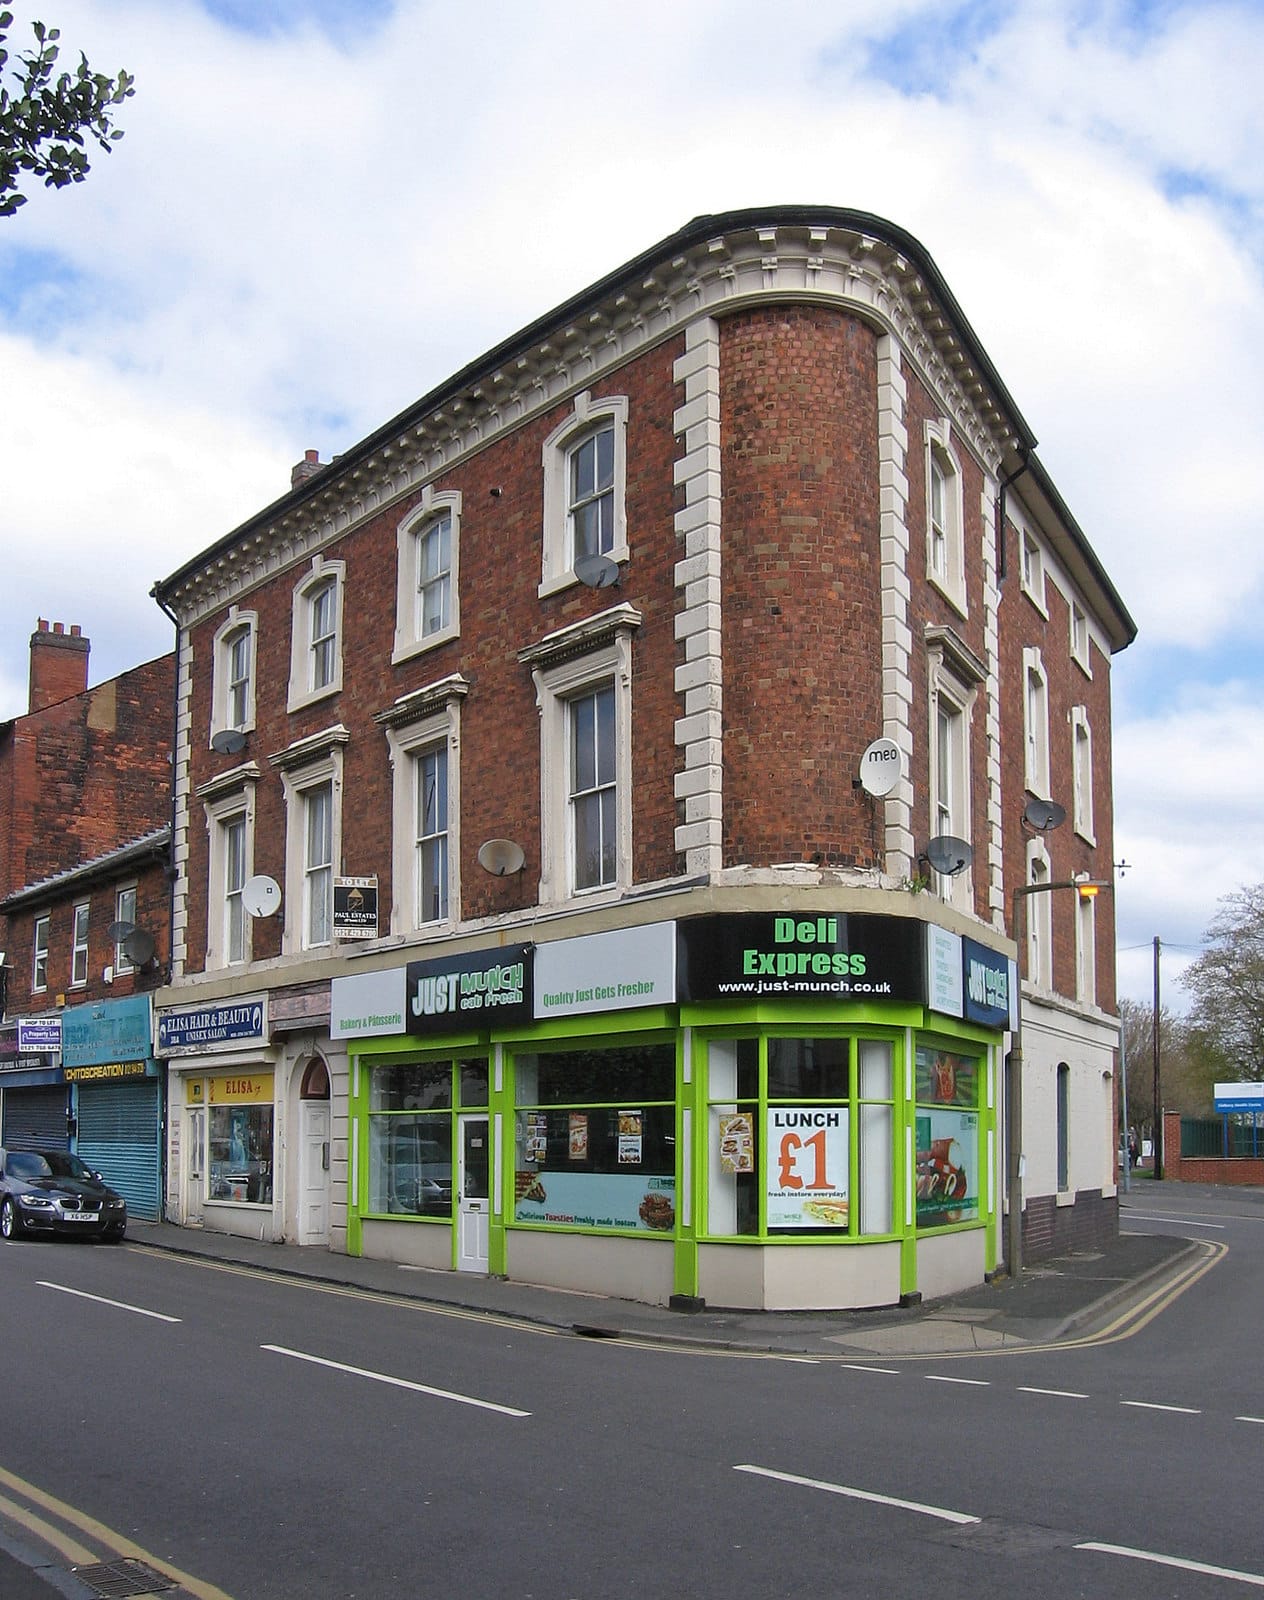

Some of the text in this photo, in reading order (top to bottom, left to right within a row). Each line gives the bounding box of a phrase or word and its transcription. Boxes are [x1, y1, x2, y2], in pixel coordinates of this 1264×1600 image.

[869, 749, 897, 762] meo
[354, 879, 370, 887] LET
[774, 918, 838, 944] Deli
[743, 950, 867, 977] Express
[412, 963, 523, 1017] JUST MUNCH
[543, 981, 655, 1008] Quality Just Gets Fresher
[718, 980, 891, 994] www.just-munch.co.uk
[485, 989, 523, 1007] fresh
[167, 1007, 253, 1033] ELISA HAIR & BEAUTY
[340, 1017, 362, 1030] Bakery
[186, 1029, 207, 1042] UNISEX
[208, 1027, 227, 1040] SALON
[226, 1079, 253, 1095] ELISA
[774, 1113, 840, 1127] LUNCH
[778, 1130, 836, 1190] £1
[813, 1190, 847, 1199] everyday!
[545, 1213, 574, 1223] Toasties
[596, 1217, 614, 1226] made
